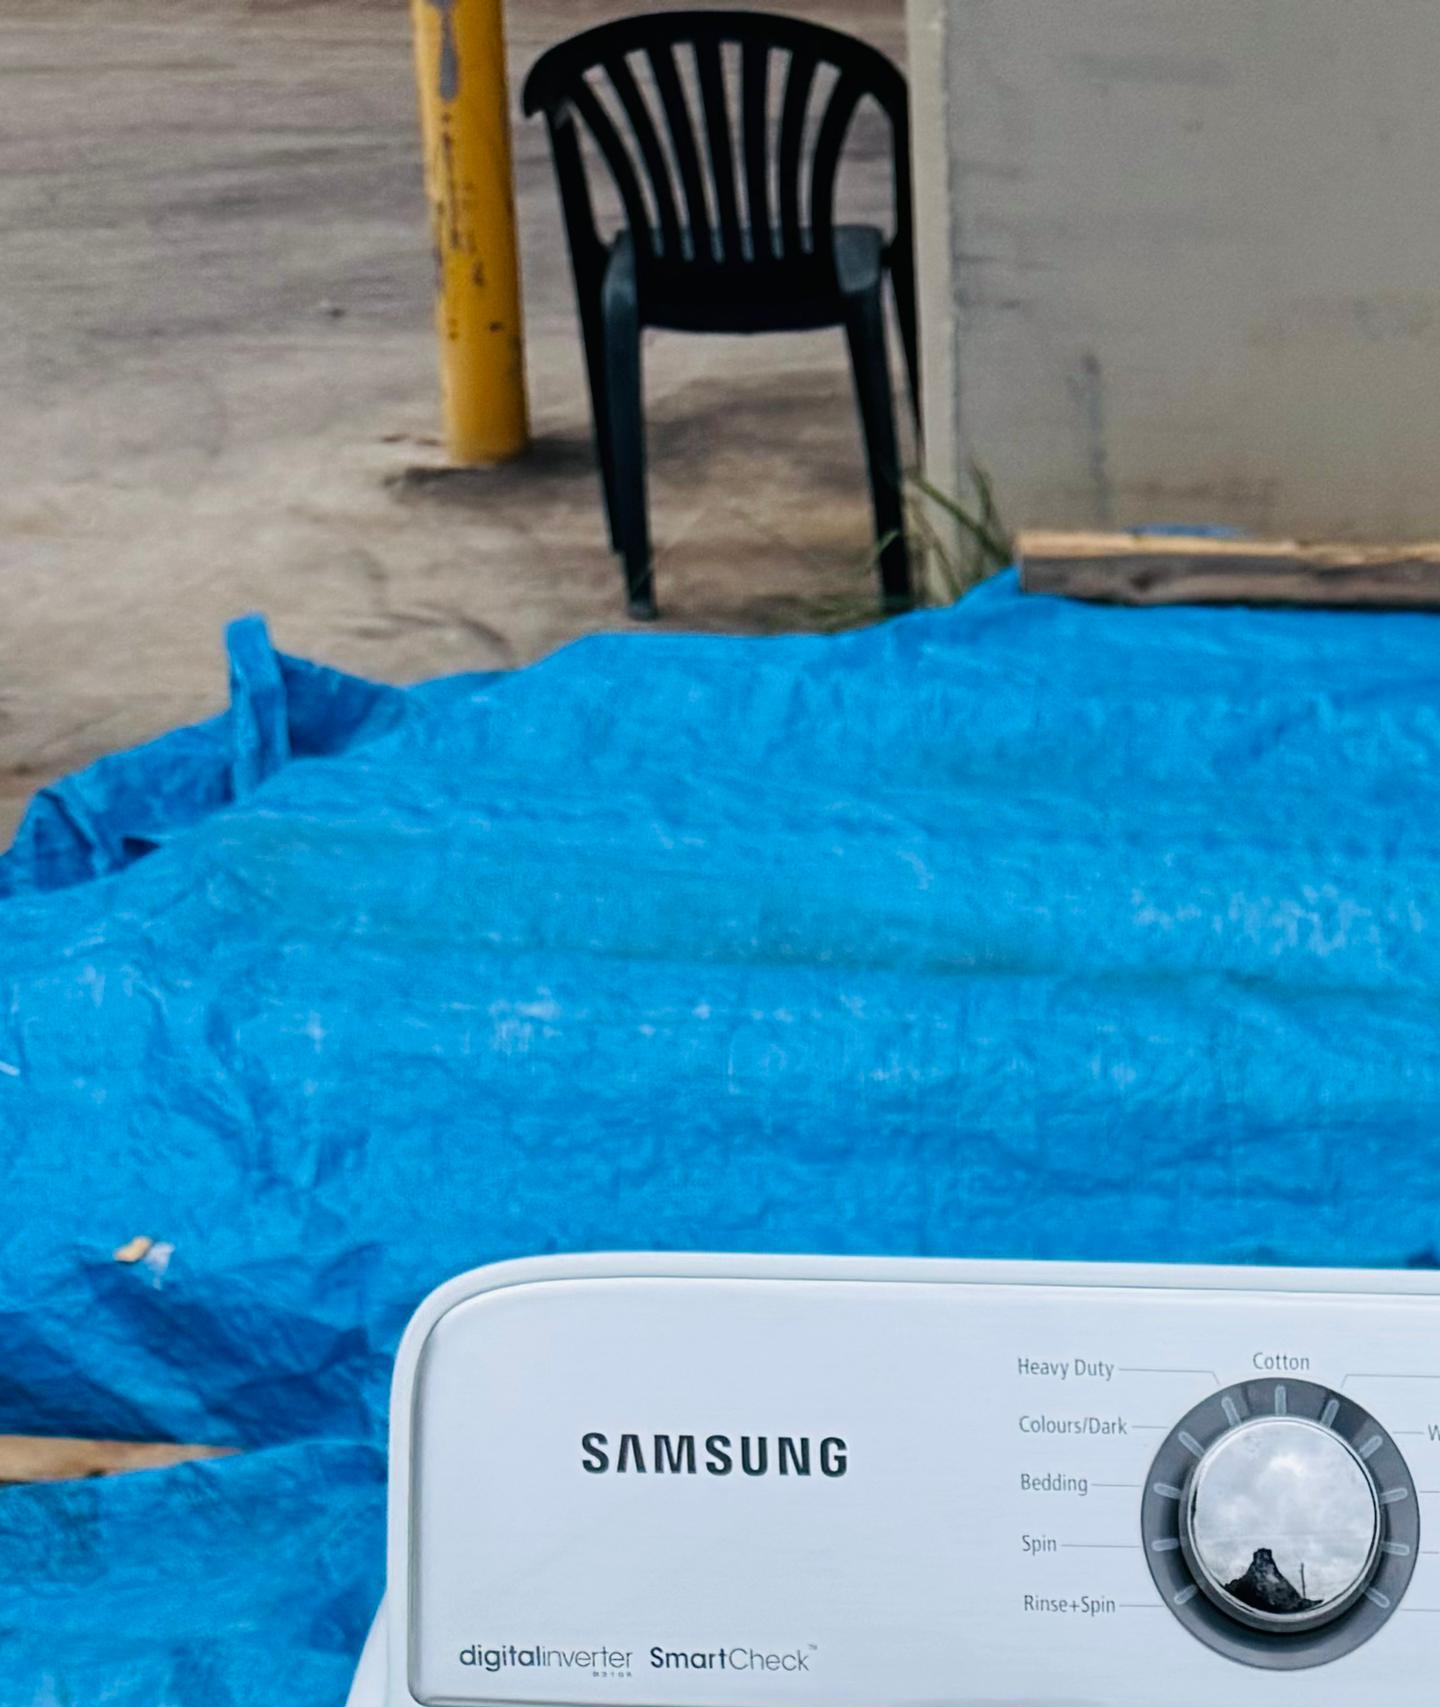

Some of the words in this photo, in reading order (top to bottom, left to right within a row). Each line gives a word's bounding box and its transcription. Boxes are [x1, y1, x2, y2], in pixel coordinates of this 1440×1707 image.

[1017, 1358, 1069, 1380] Heavy
[1074, 1360, 1115, 1381] Duty
[1252, 1351, 1310, 1370] Cotton
[1018, 1415, 1128, 1436] Colours/Dark
[581, 1432, 849, 1478] SAMSUNG
[1020, 1473, 1088, 1497] Bedding
[1021, 1535, 1057, 1556] Spin
[1023, 1595, 1116, 1618] Rinse+Spin
[459, 1644, 633, 1672] digitalinverter
